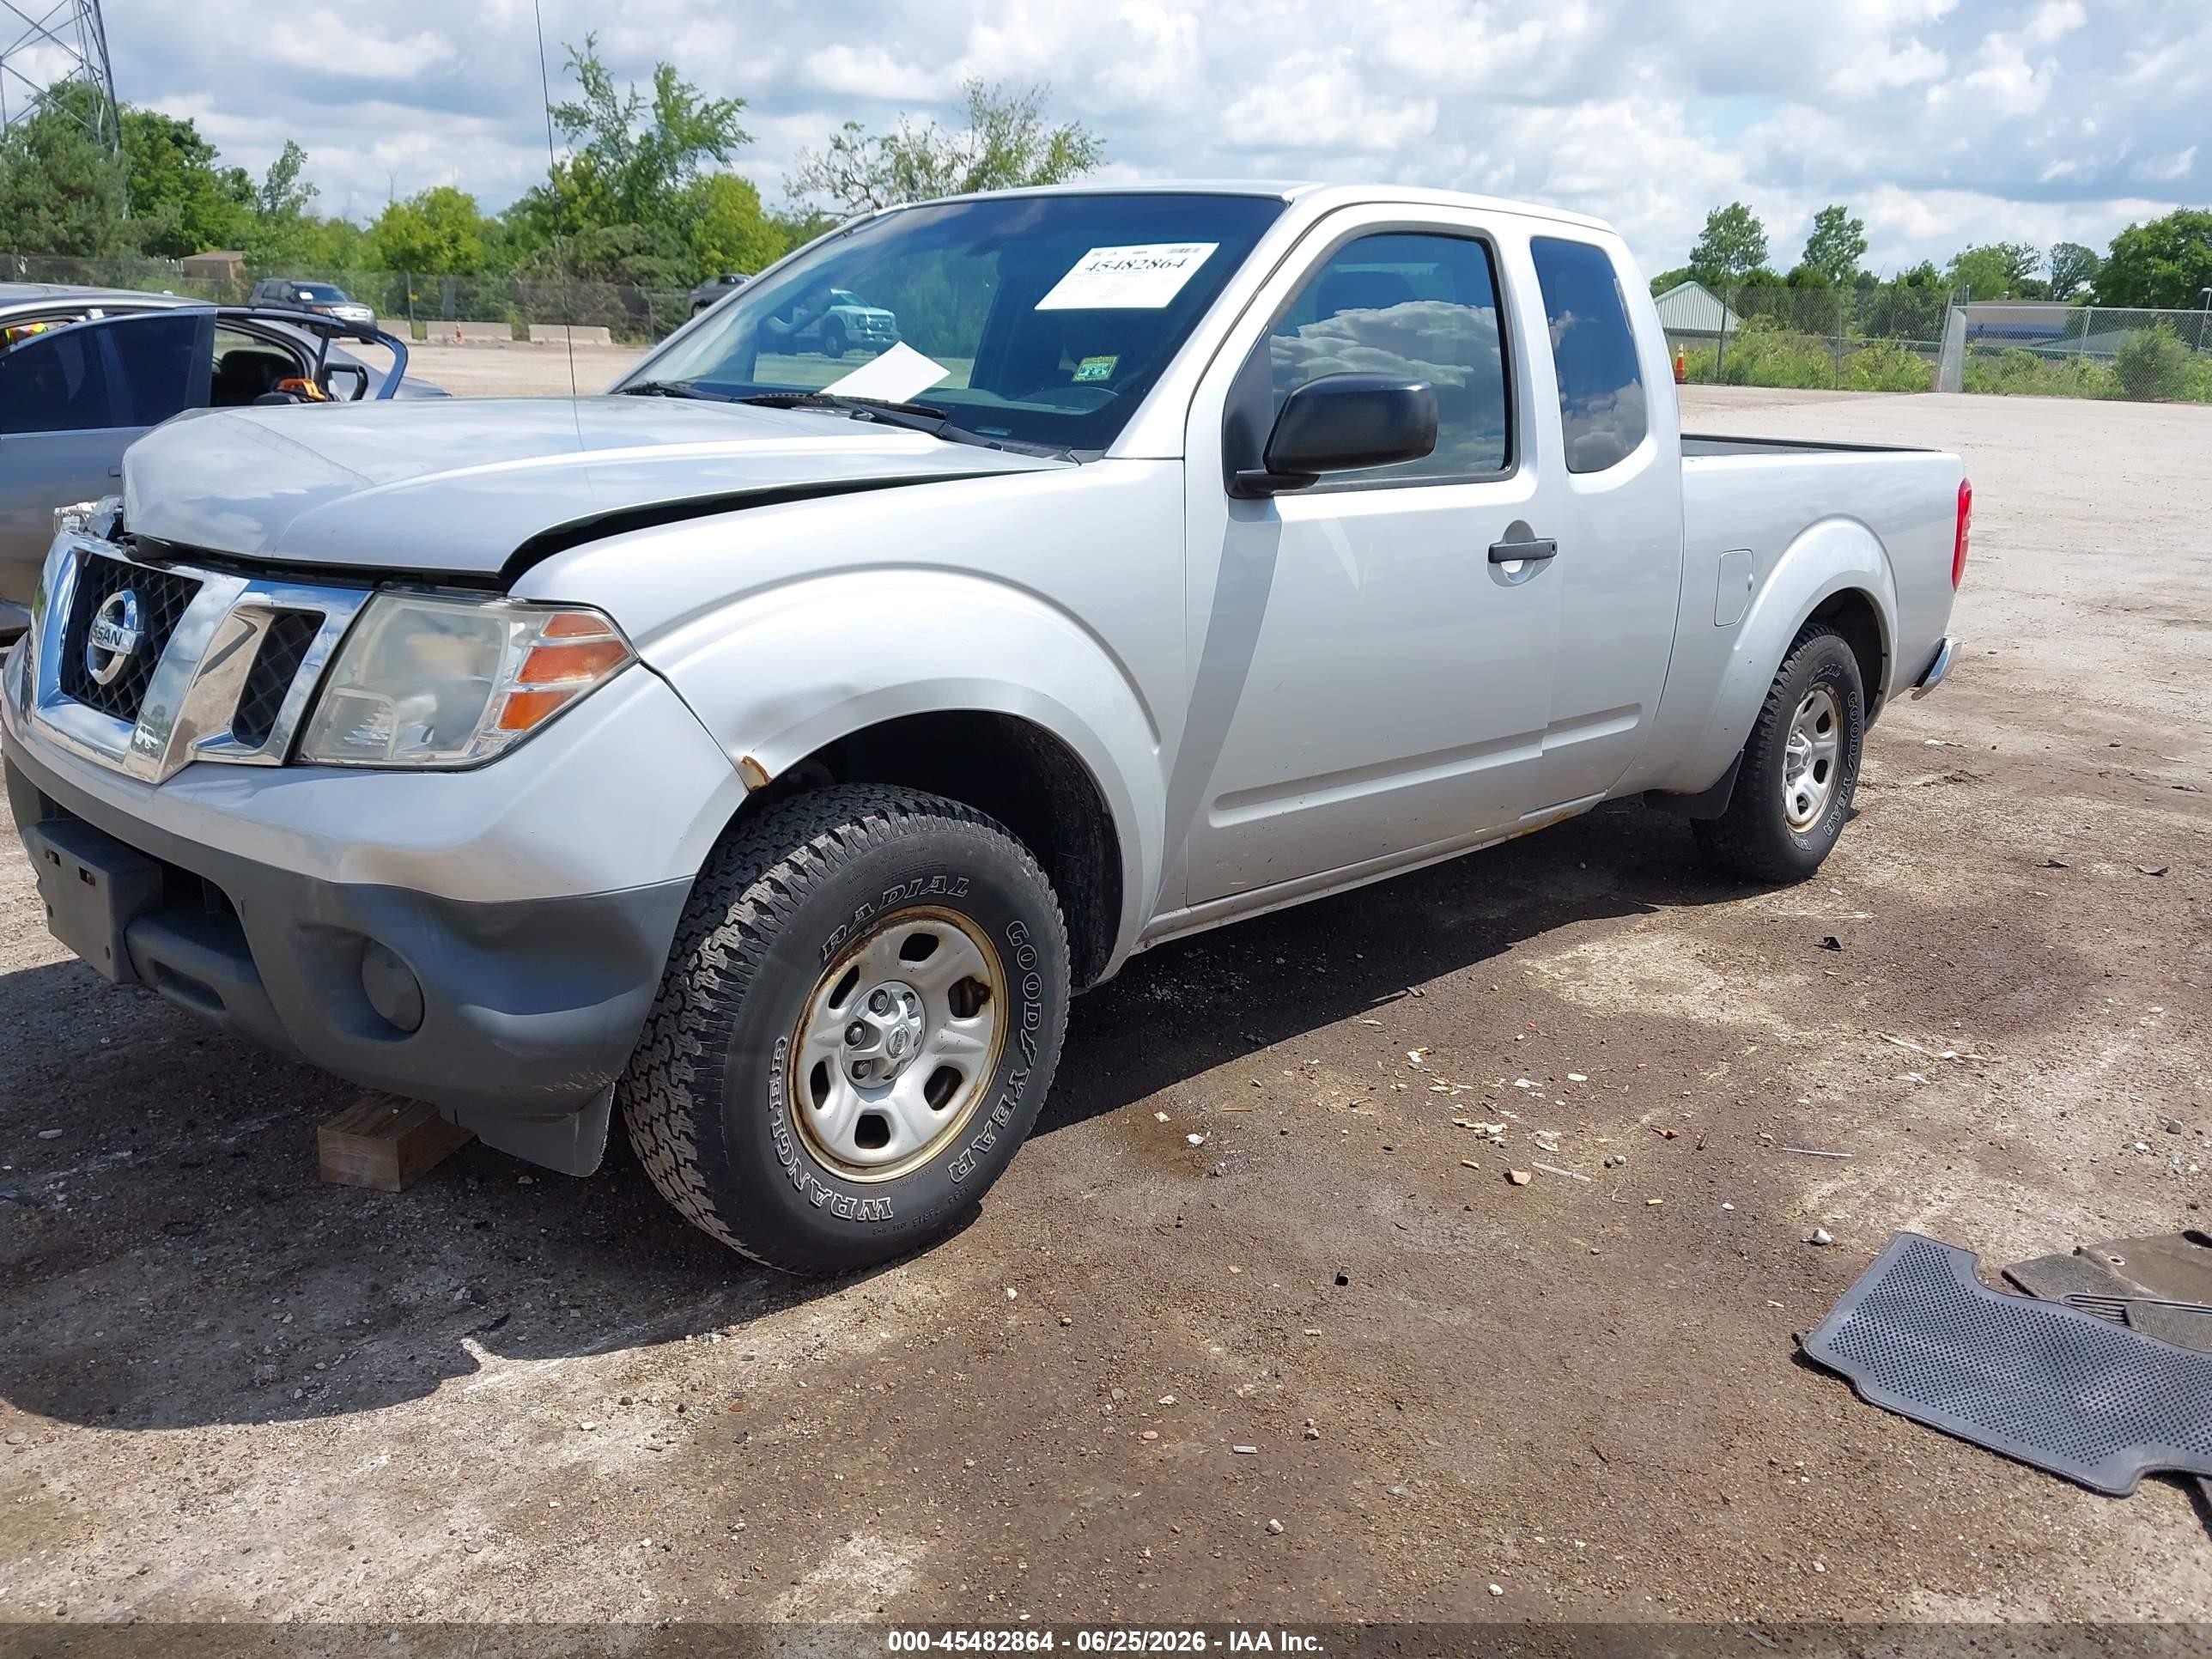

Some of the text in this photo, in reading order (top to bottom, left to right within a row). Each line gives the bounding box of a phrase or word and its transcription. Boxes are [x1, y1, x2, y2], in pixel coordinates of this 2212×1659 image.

[1085, 257, 1188, 271] 45482864
[821, 875, 970, 962] RADIAL
[767, 1034, 895, 1222] WRANGLER
